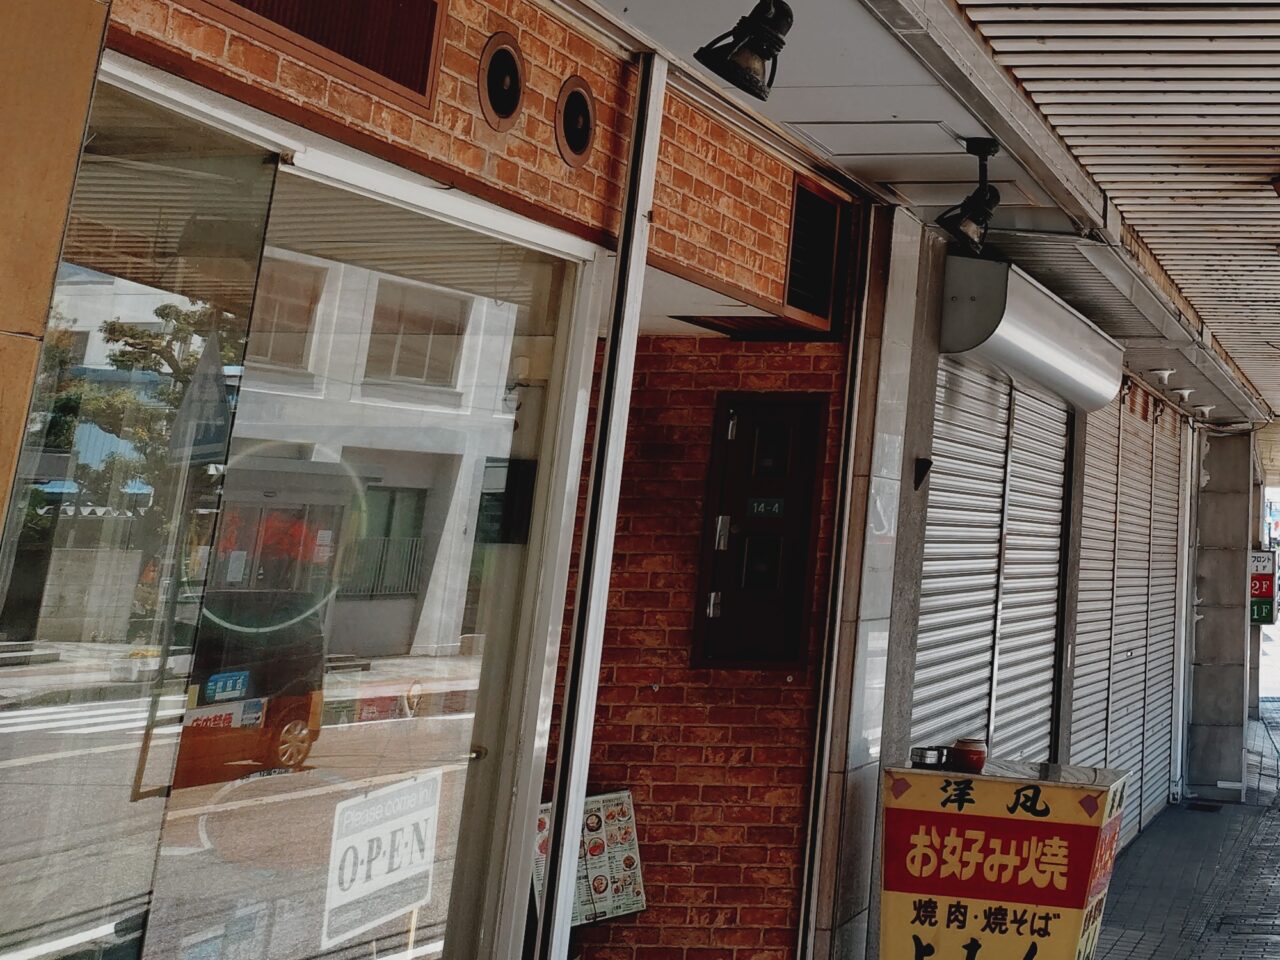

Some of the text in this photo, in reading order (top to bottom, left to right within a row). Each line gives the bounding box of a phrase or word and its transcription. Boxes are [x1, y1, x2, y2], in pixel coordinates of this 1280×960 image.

[752, 503, 779, 513] 14-4
[1251, 580, 1269, 594] 2F
[1252, 604, 1270, 619] 1F
[343, 803, 383, 834] Please
[385, 792, 417, 816] come
[906, 825, 1069, 890] お好み焼
